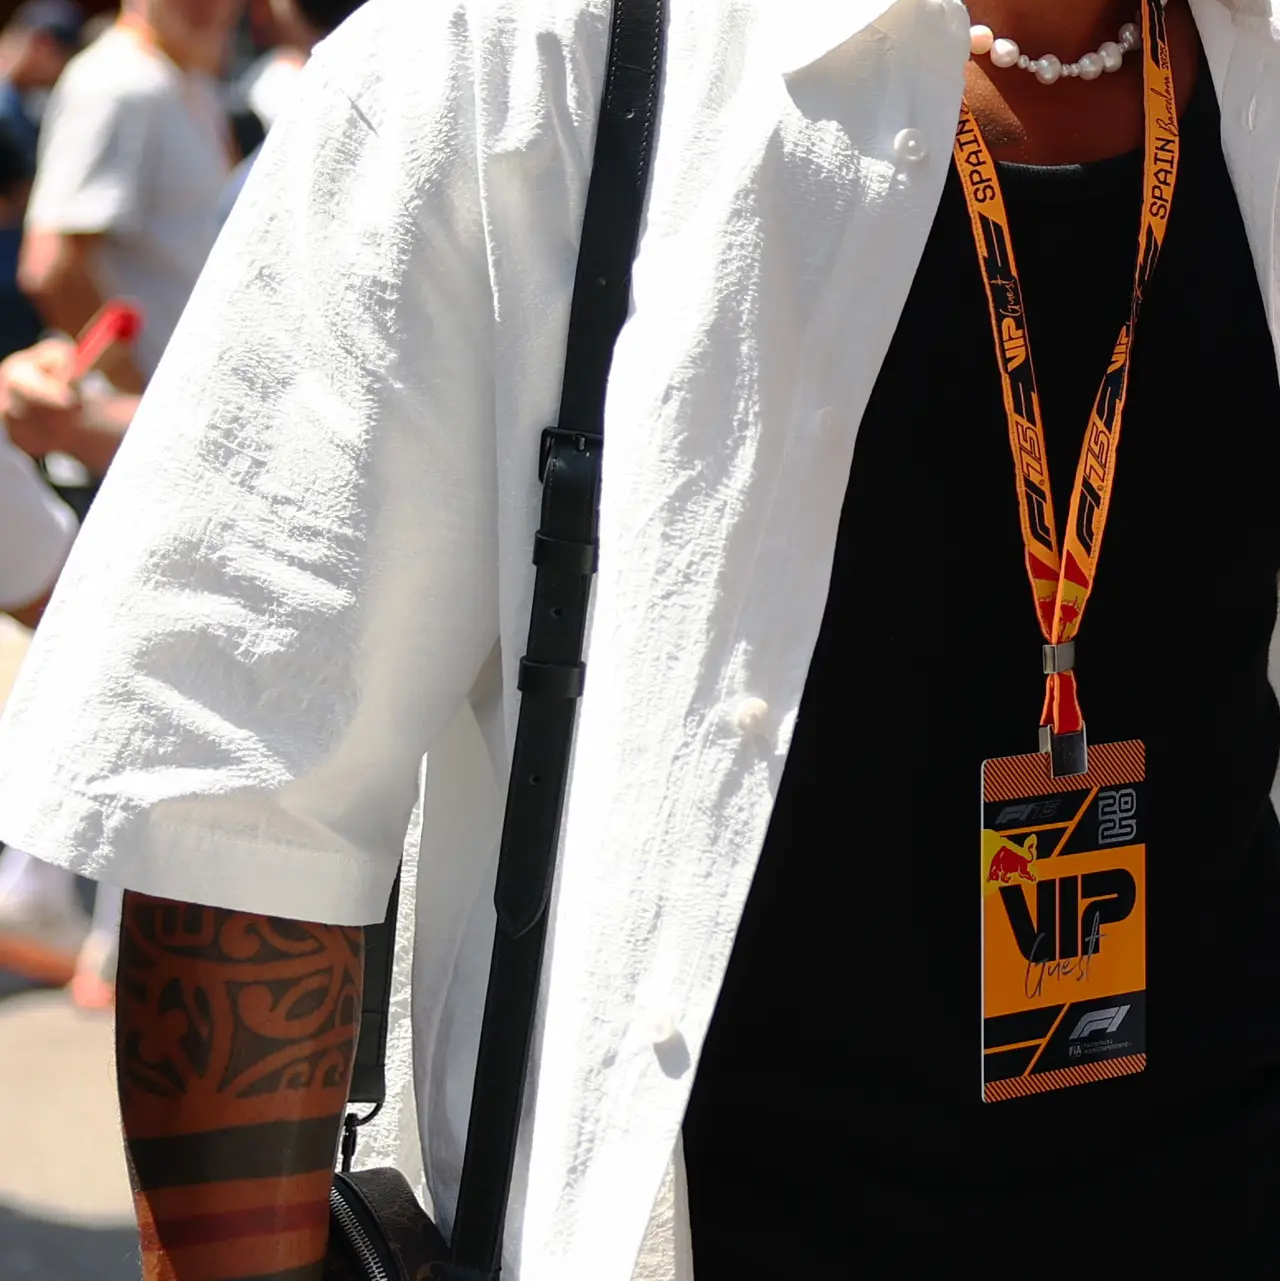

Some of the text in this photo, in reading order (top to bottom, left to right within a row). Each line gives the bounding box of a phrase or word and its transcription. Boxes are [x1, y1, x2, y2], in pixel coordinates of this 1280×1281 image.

[956, 118, 996, 204] SPAIN
[1150, 137, 1176, 220] SPAIN
[1002, 317, 1028, 372] VIP
[1107, 324, 1129, 375] VIP
[998, 867, 1137, 964] VIP
[1024, 910, 1107, 999] Guest
[1069, 1004, 1131, 1040] F1
